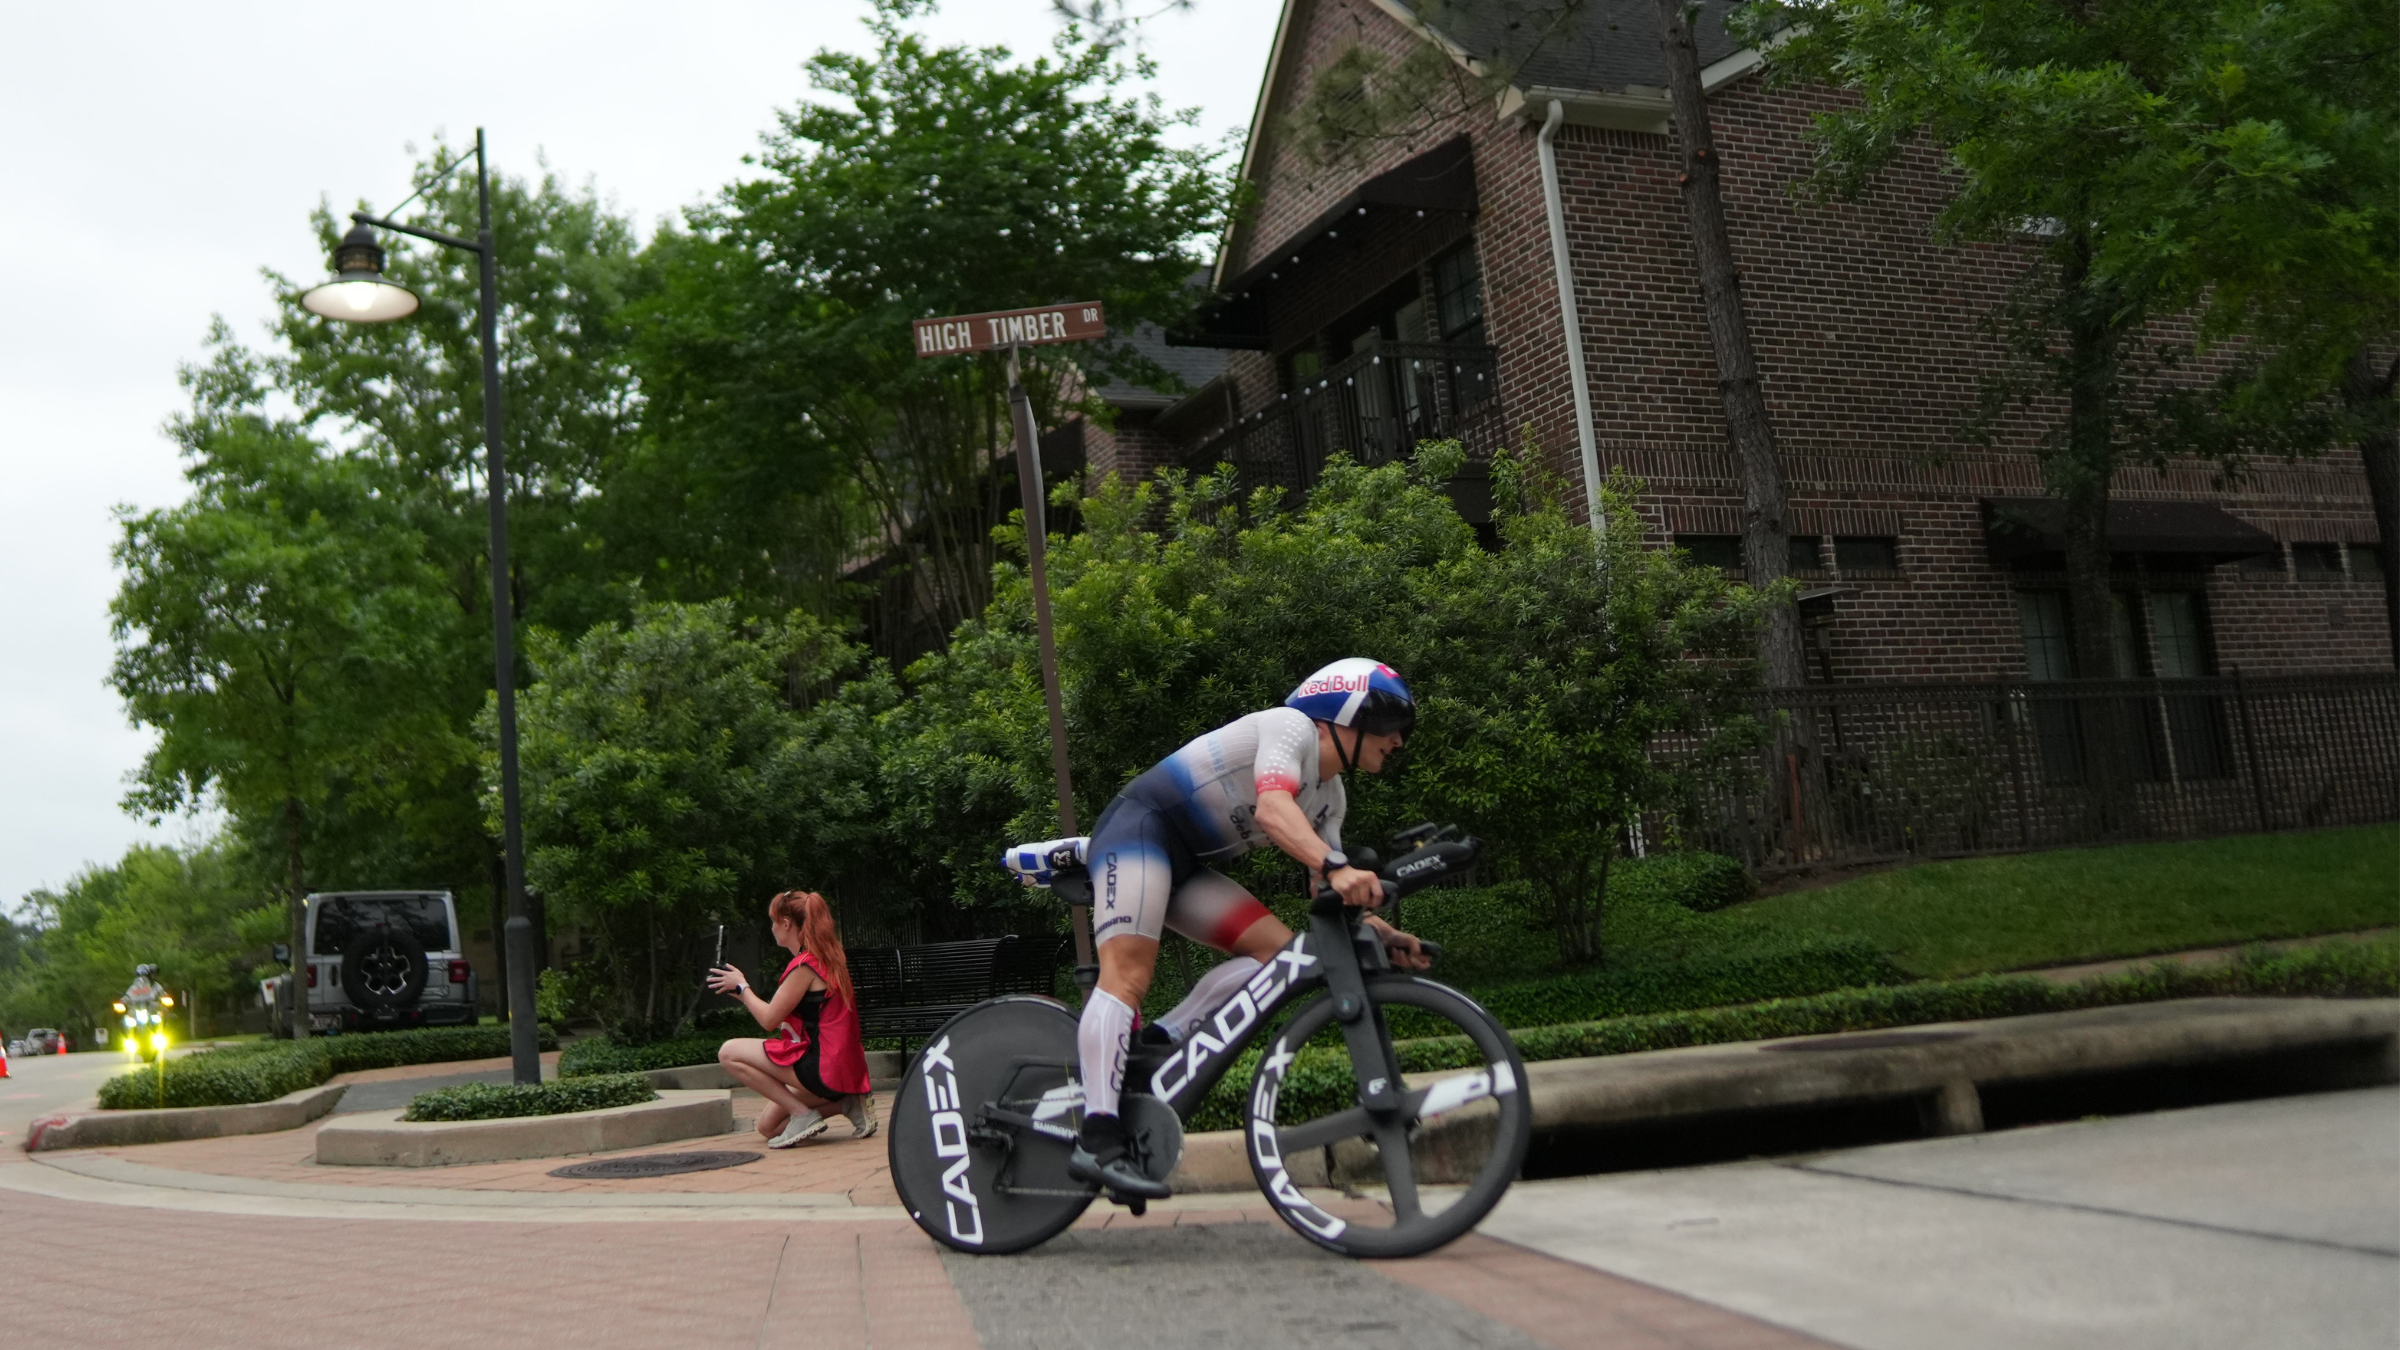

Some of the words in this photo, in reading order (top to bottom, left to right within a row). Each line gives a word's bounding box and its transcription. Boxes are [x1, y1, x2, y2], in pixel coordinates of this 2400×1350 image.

[919, 321, 972, 352] HIGH
[988, 311, 1067, 345] TIMBER
[1083, 308, 1099, 323] DR
[1299, 675, 1331, 697] Red
[1332, 674, 1368, 693] Bull
[1106, 852, 1117, 910] CADEX
[1396, 854, 1447, 877] CADEX
[1151, 933, 1317, 1102] CADEX
[923, 1035, 984, 1245] CADEX
[1253, 1036, 1347, 1239] CADEX
